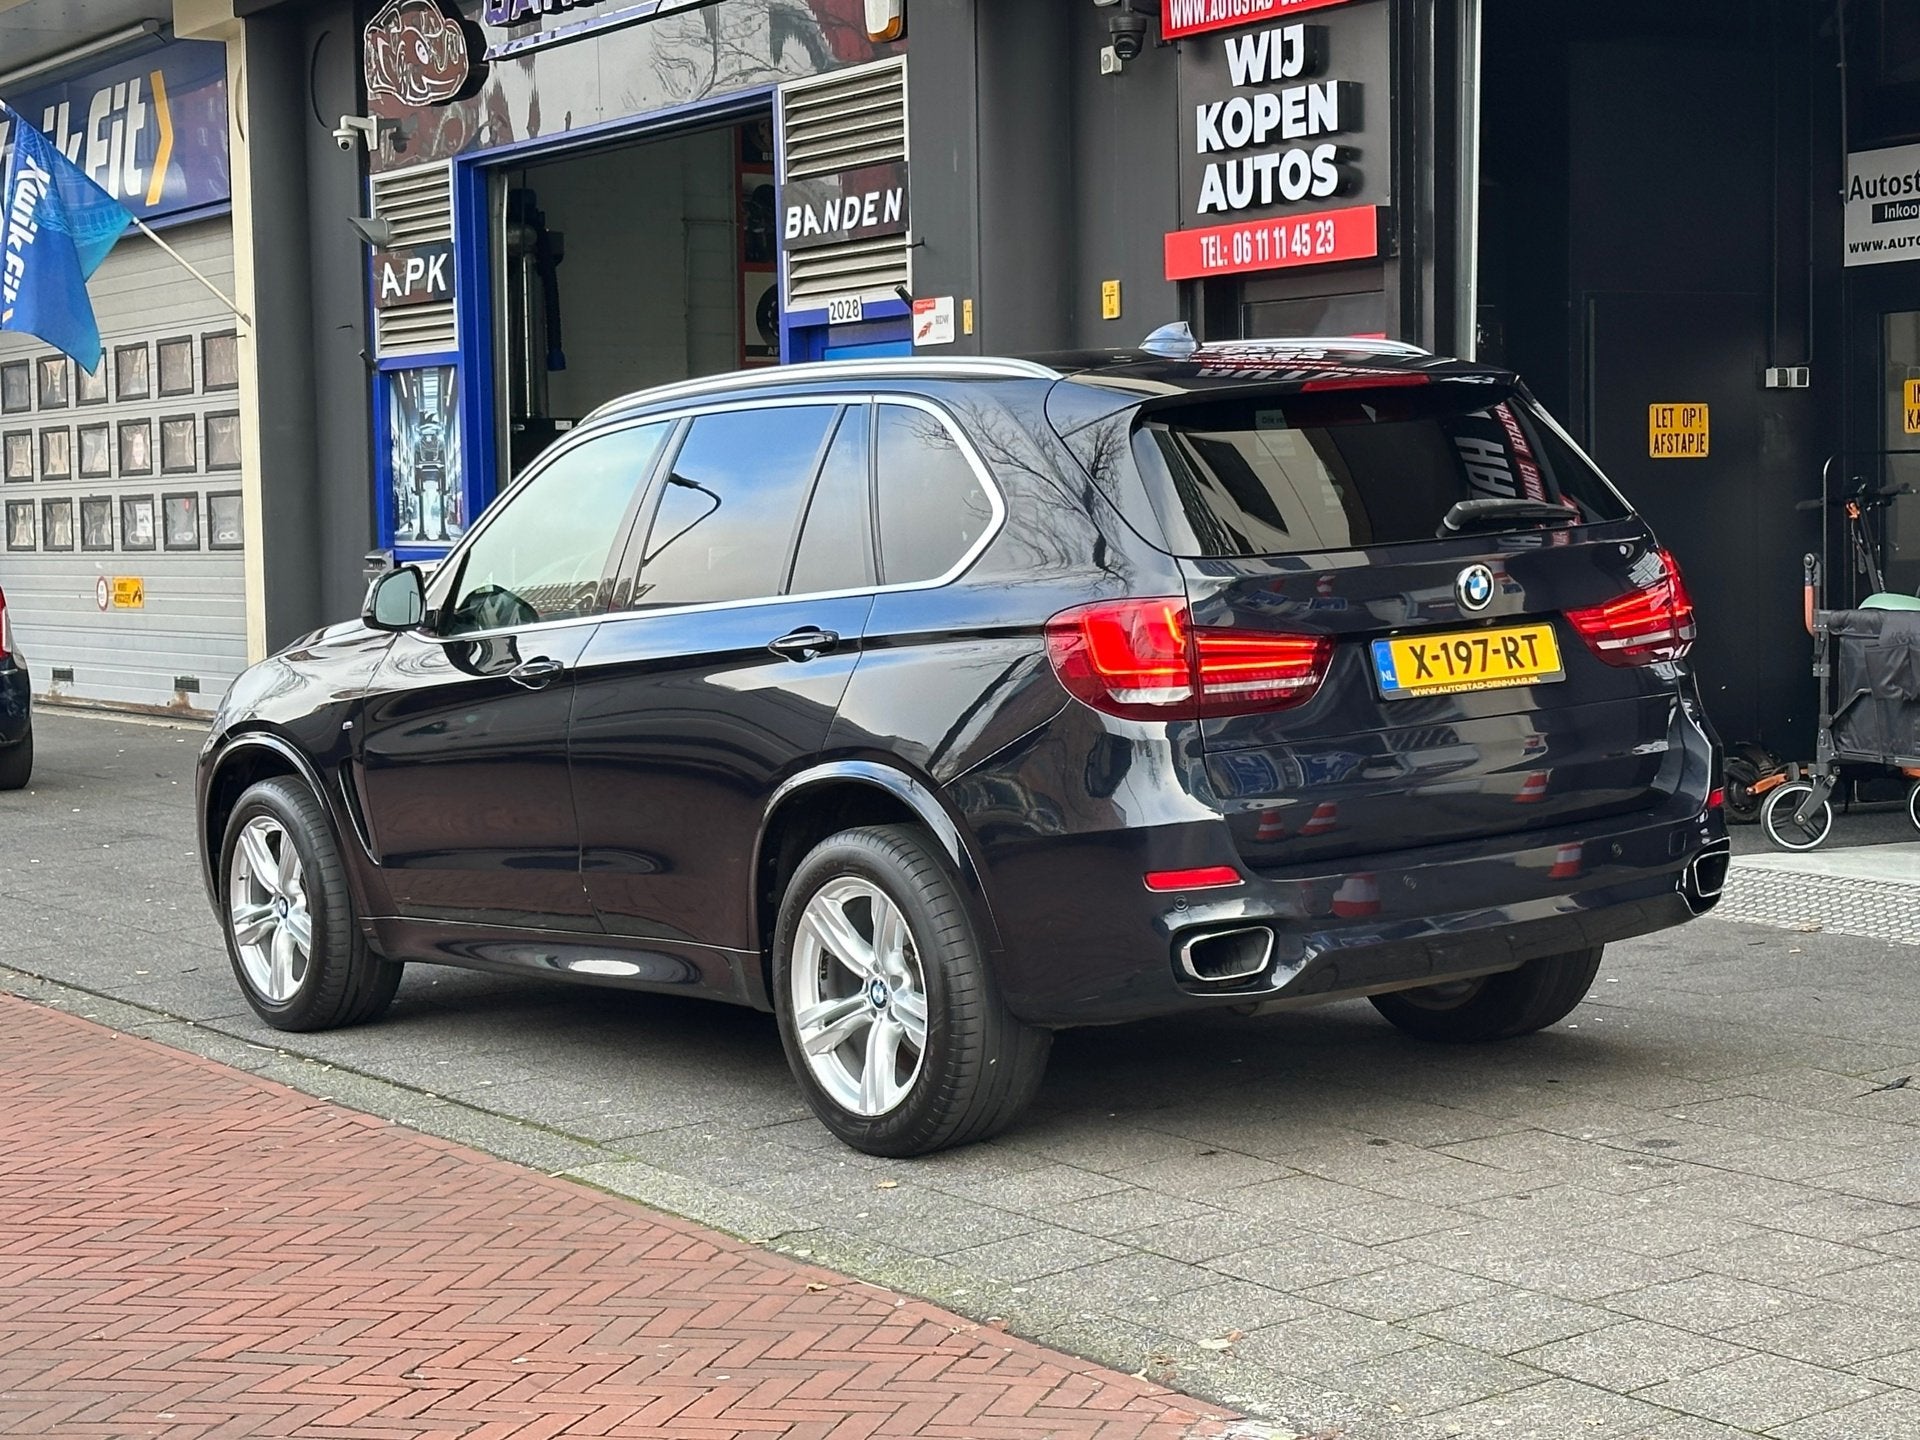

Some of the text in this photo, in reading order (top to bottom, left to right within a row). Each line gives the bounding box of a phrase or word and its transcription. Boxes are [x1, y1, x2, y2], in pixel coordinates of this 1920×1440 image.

[1171, 0, 1273, 29] WWW.AUTO
[1224, 23, 1305, 87] WIJ
[1196, 79, 1338, 154] KOPEN
[1196, 143, 1339, 214] AUTOS
[784, 187, 904, 240] BANDEN
[1884, 203, 1920, 219] Inkoo
[1200, 219, 1335, 269] TEL: 06 11 11 45 23
[381, 253, 449, 299] APK
[830, 300, 861, 321] 2028
[1655, 408, 1674, 428] LET
[1653, 433, 1706, 454] AFSTAPJE
[1381, 670, 1396, 682] NL
[1408, 634, 1538, 680] X-197-RT
